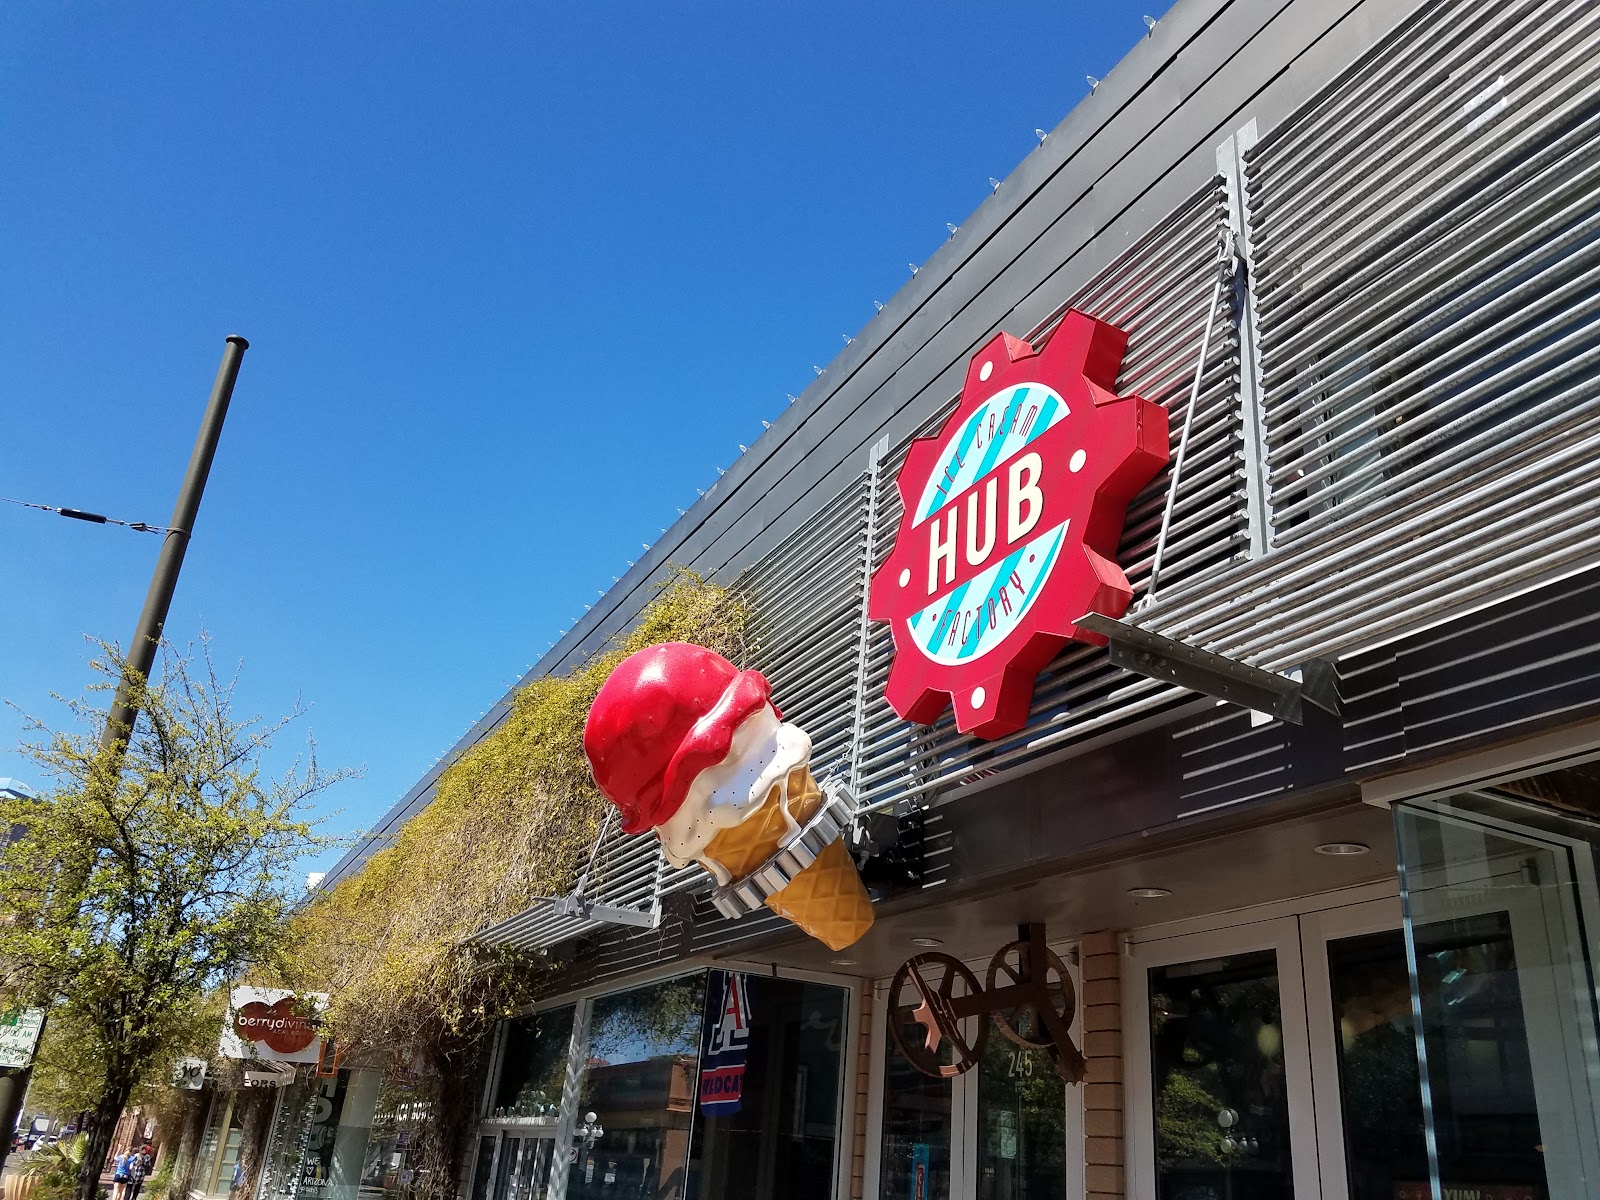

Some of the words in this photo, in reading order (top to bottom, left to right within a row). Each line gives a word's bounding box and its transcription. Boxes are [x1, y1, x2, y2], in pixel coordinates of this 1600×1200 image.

[936, 447, 966, 495] ICE
[976, 403, 1043, 449] CREAM
[928, 451, 1044, 597] HUB
[935, 569, 1026, 646] FACTORY
[21, 1030, 33, 1038] AM
[1008, 1050, 1033, 1078] 245
[302, 1176, 334, 1188] ARIZONA
